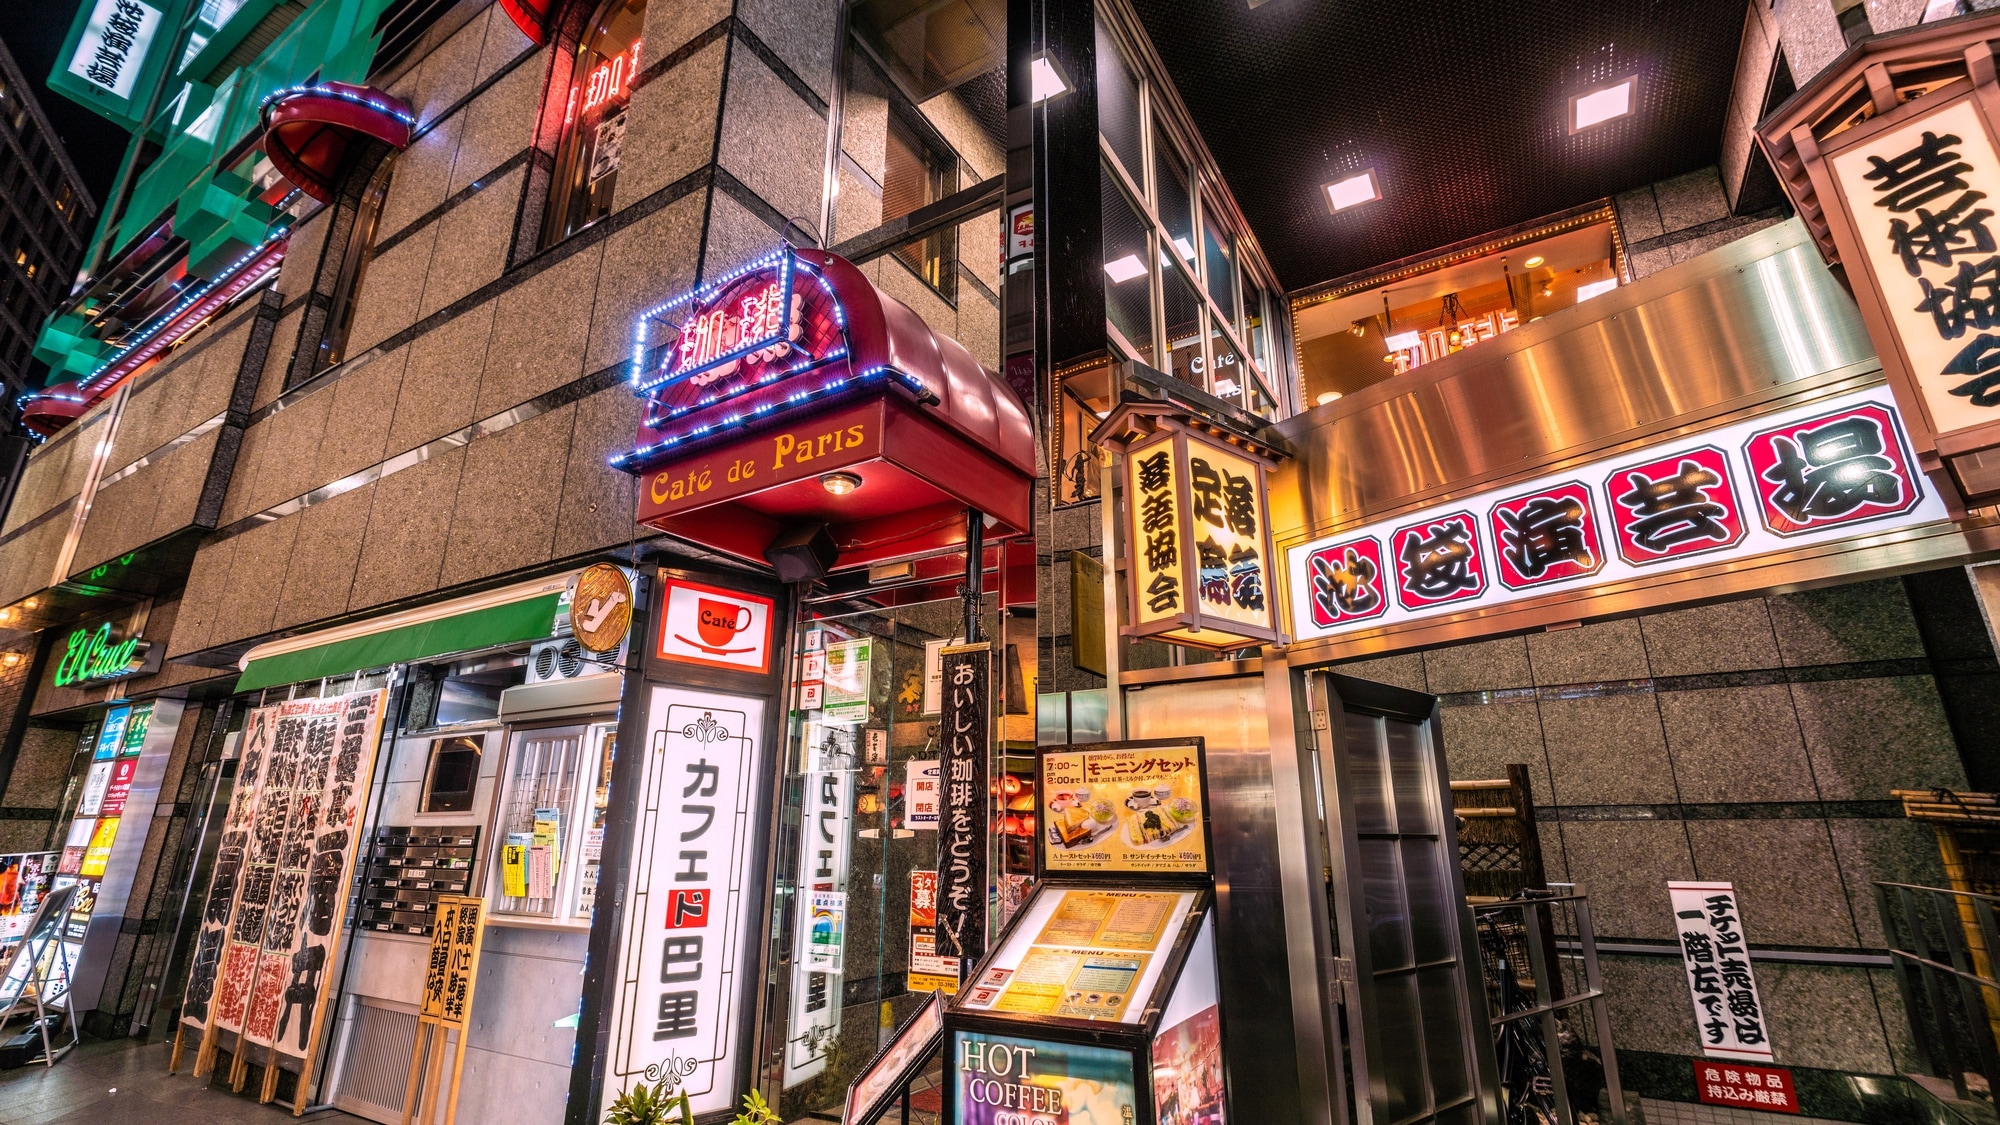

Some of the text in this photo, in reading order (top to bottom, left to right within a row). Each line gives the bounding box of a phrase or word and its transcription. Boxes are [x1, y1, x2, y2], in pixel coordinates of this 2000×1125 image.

[1190, 351, 1236, 374] Cfé
[650, 423, 865, 505] Café de Paris
[1137, 450, 1180, 615] 落語協会
[1312, 416, 1904, 620] 池袋演芸場
[700, 609, 736, 630] Café
[1087, 756, 1196, 776] モーニングセット
[948, 662, 976, 938] おいしい珈琲をどうぞ!
[652, 757, 721, 1043] カフェド巴里
[1676, 909, 1730, 1045] 一階左です
[1703, 894, 1767, 1046] チケット売場は
[961, 1041, 1036, 1080] HOT
[1703, 1067, 1784, 1090] 危険物品
[969, 1078, 1063, 1116] COFFEE
[1706, 1083, 1789, 1108] 持込み厳禁
